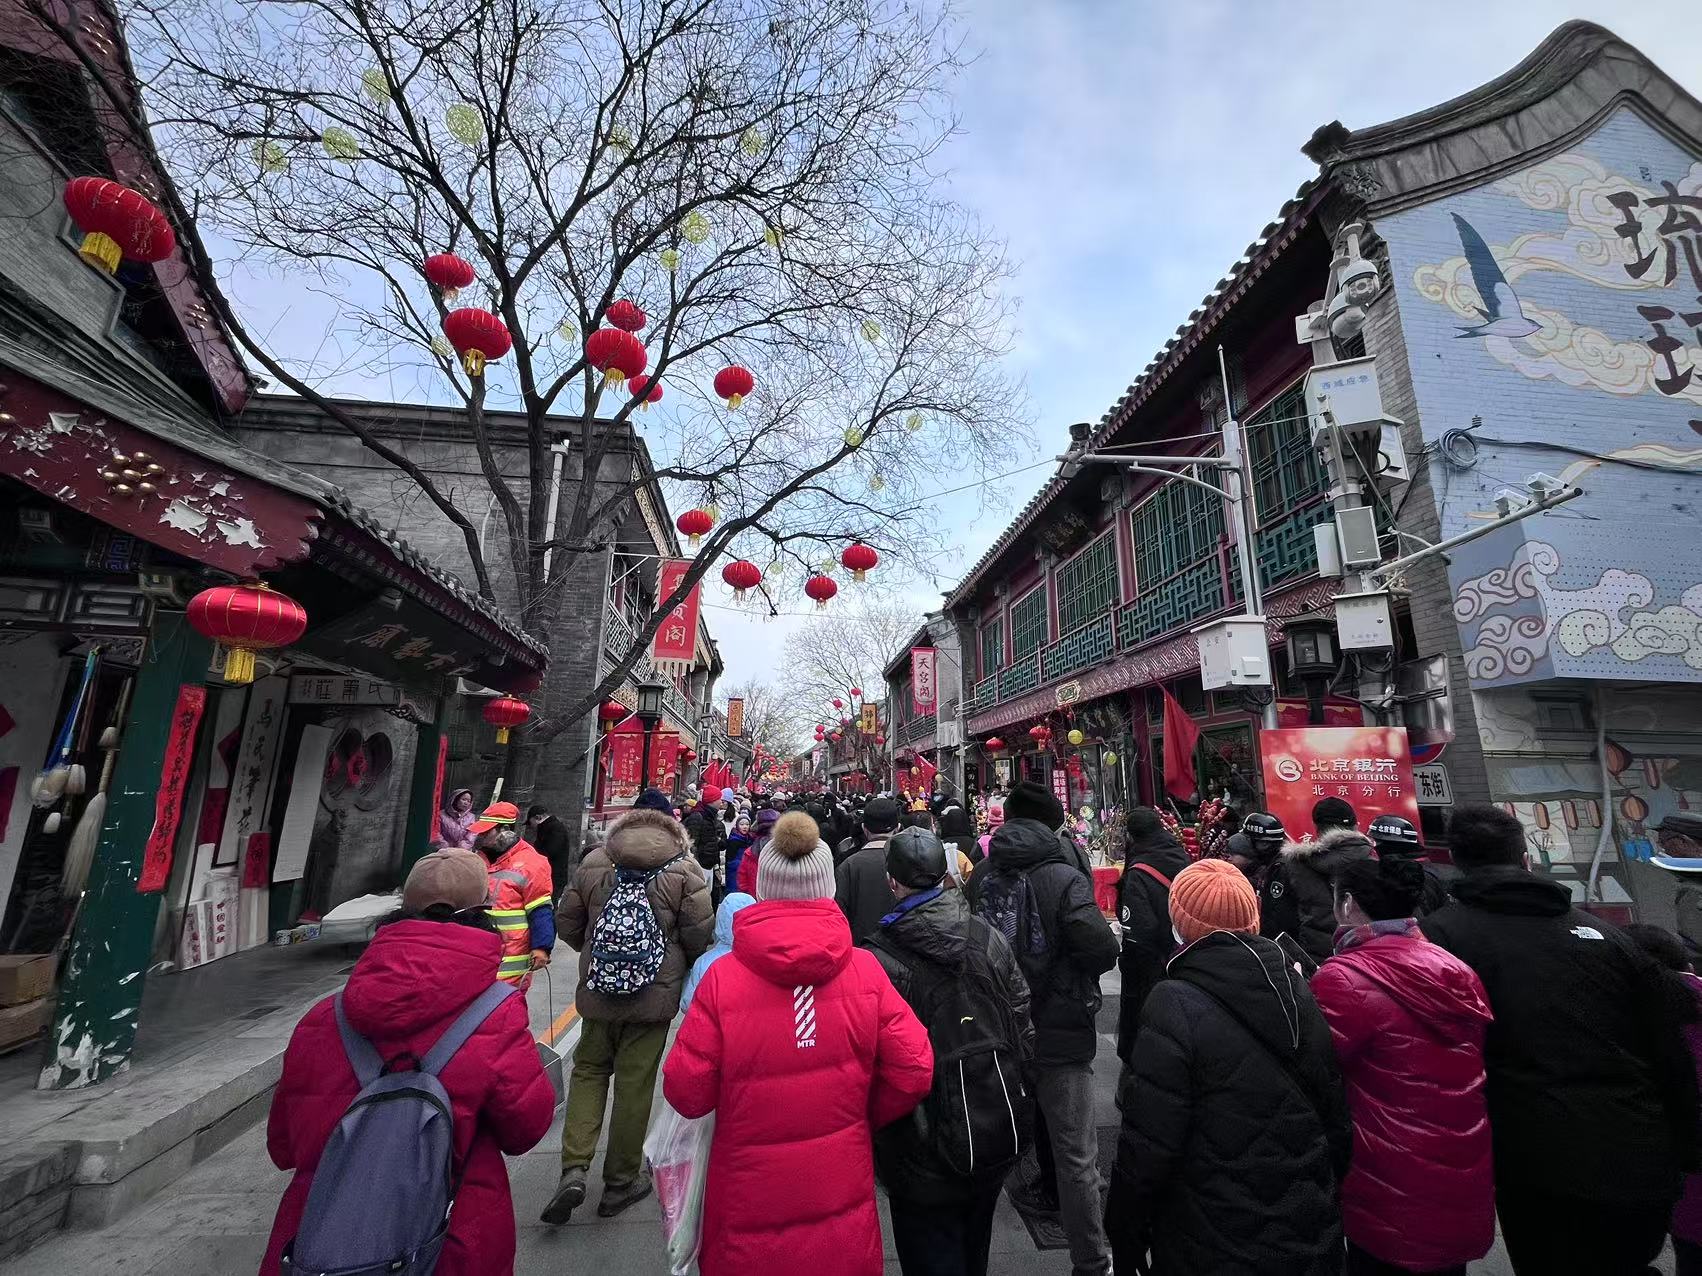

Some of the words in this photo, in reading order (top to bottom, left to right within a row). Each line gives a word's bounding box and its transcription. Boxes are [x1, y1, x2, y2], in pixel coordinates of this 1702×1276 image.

[1309, 758, 1398, 774] 北京银行
[1310, 773, 1338, 781] BANK
[1340, 773, 1355, 781] OF
[1357, 773, 1399, 782] BEIJING
[1414, 771, 1445, 798] 东街
[1312, 785, 1401, 797] 北京分行
[797, 1039, 815, 1049] MTR
